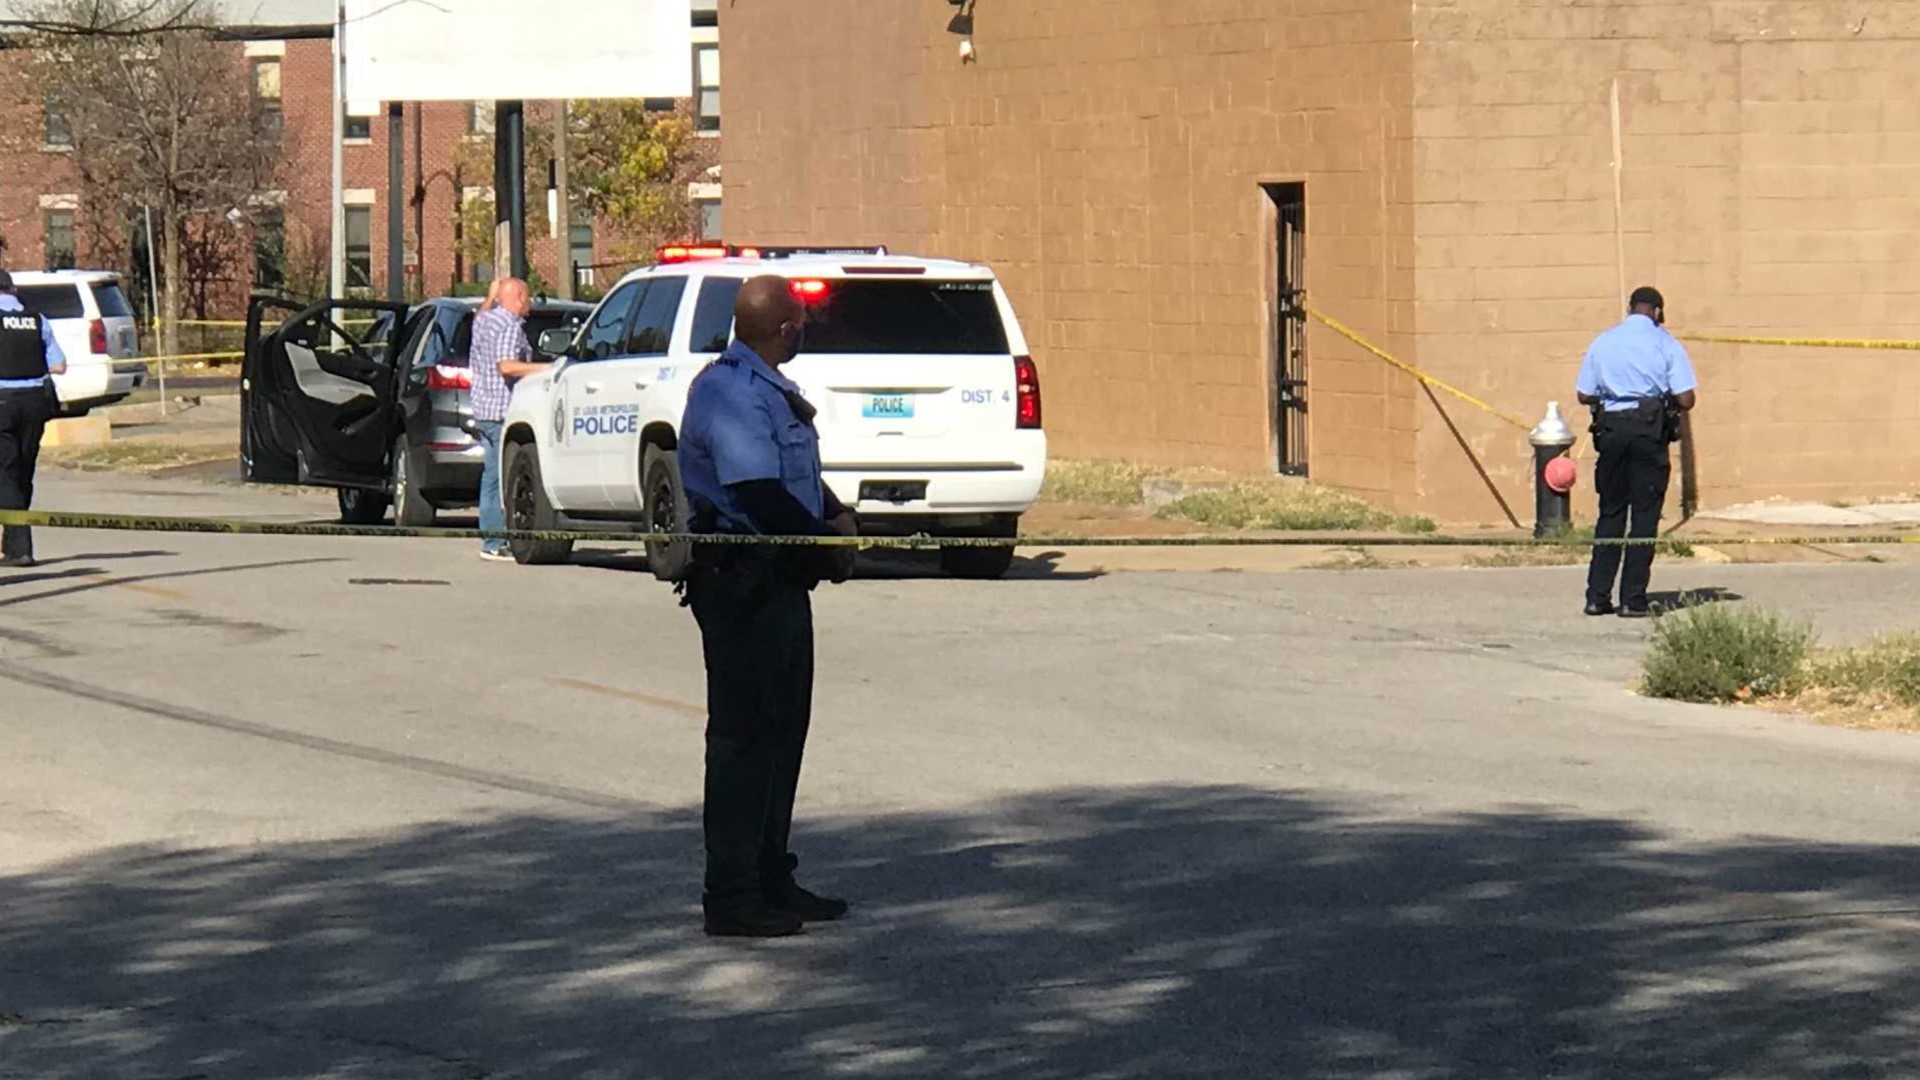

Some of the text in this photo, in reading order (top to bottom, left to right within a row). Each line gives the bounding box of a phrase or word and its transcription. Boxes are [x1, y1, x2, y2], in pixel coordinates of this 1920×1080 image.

[2, 316, 37, 330] POLICE
[1001, 389, 1010, 403] 4
[872, 397, 904, 413] POLICE
[573, 415, 638, 435] POLICE
